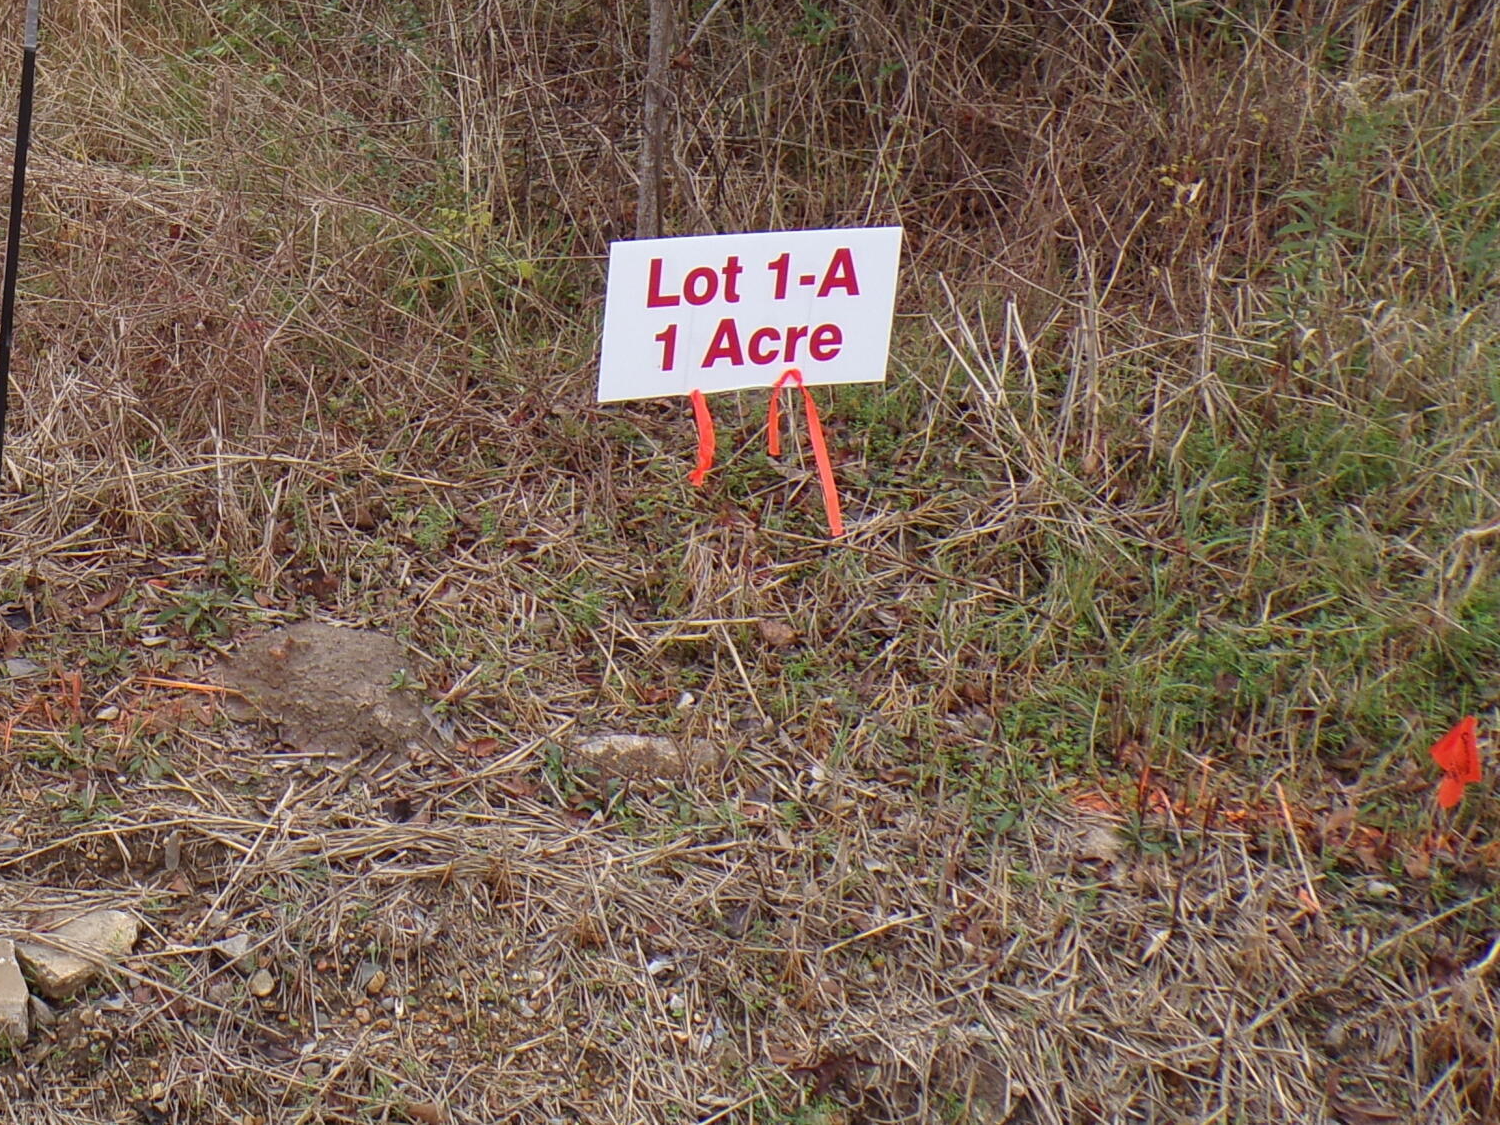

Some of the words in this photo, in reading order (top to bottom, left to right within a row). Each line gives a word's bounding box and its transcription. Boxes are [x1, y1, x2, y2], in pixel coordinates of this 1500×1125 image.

[646, 255, 743, 308] Lot
[767, 247, 860, 299] 1-A
[655, 324, 677, 371] 1
[701, 318, 843, 368] Acre
